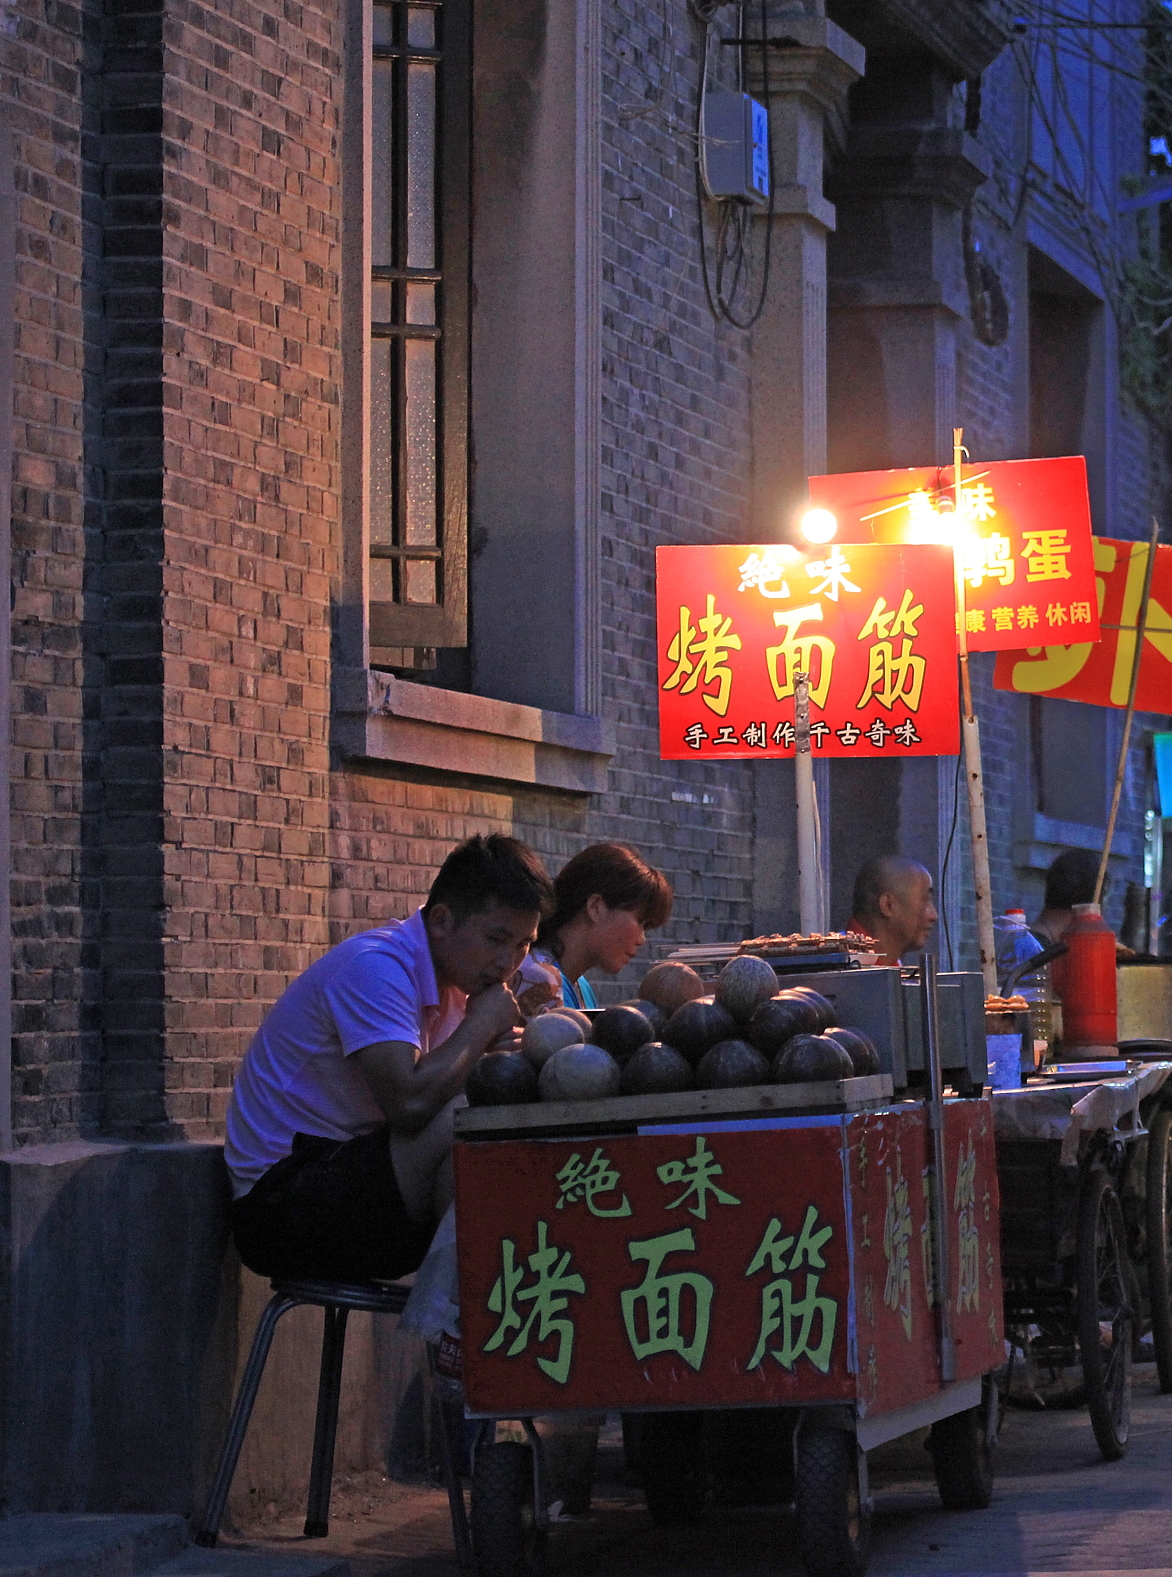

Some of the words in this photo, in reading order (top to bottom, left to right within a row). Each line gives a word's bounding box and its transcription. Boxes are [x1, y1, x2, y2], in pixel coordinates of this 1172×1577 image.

[963, 529, 1072, 588] 鹑蛋
[662, 589, 927, 717] 烤面筋
[992, 605, 1040, 632] 营养
[1045, 601, 1092, 627] 休闲
[483, 1205, 838, 1385] 烤面筋
